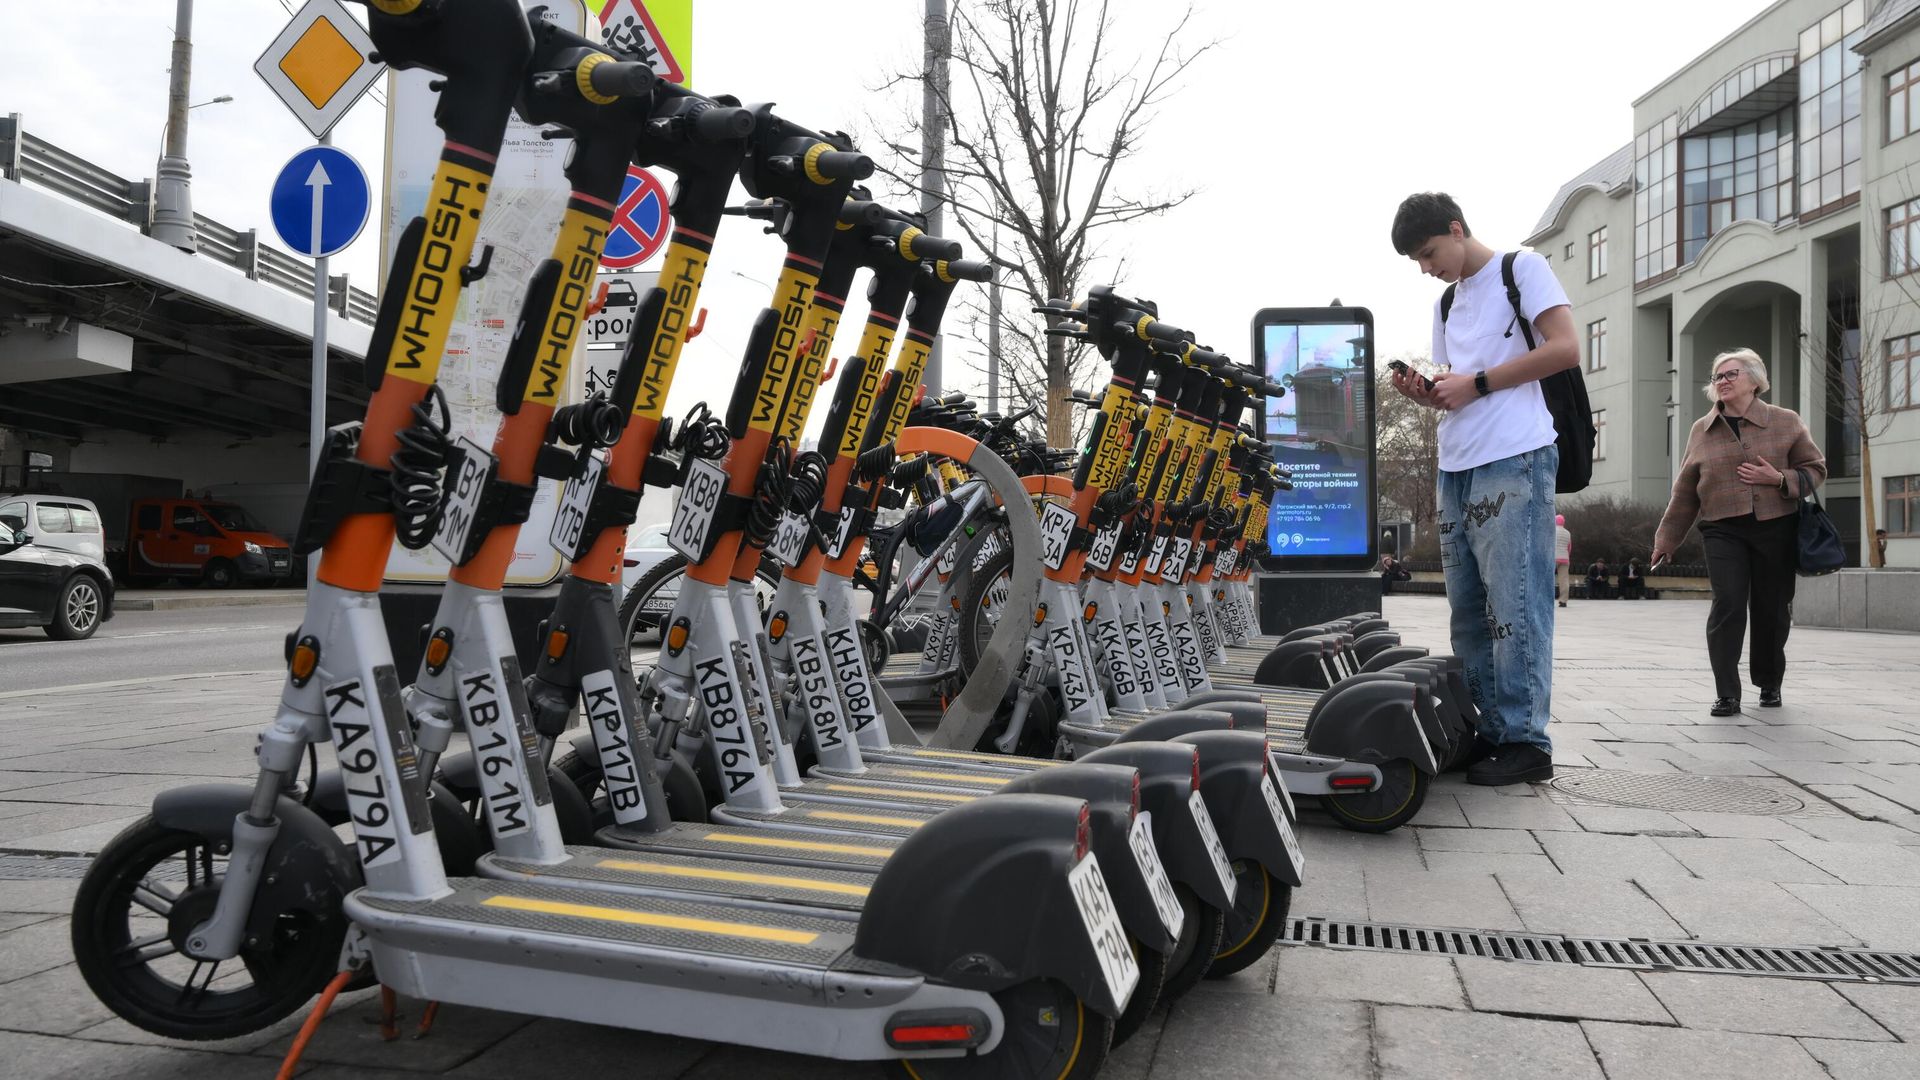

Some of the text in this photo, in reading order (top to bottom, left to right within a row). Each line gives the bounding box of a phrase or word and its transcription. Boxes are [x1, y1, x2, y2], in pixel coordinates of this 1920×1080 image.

[522, 139, 554, 147] Толстого
[395, 175, 470, 370] WHOOSH
[532, 225, 603, 397] WHOOSH
[637, 257, 699, 410] WHOOSH
[752, 280, 812, 422] WHOOSH
[785, 317, 835, 442] WHOOSH
[842, 335, 891, 452] WHOOSH
[1091, 395, 1129, 483] WHOOSH
[1138, 413, 1168, 493] WHOOSH
[1158, 425, 1189, 501] WHOOSH
[1276, 463, 1320, 471] Посетите
[685, 467, 719, 513] КВ8
[1323, 478, 1359, 488] войны»
[558, 503, 583, 549] 17В
[674, 504, 705, 554] 76А
[1042, 509, 1071, 540] КР4
[924, 613, 948, 663] КХ914К
[1098, 620, 1135, 696] КК466В
[1146, 621, 1180, 688] КМ049Т
[1173, 621, 1204, 689] КА292А
[1196, 611, 1218, 660] КХ983К
[1227, 602, 1245, 640] КР875К
[794, 639, 842, 749] КВ568М
[829, 629, 876, 732] КН308А
[1051, 627, 1087, 712] КР443А
[463, 673, 527, 834] КВ161М
[587, 686, 641, 812] КР117В
[696, 657, 756, 794] КВ876А
[325, 682, 396, 865] КА979А
[1074, 863, 1110, 933] КА9
[1097, 920, 1134, 993] 79А
